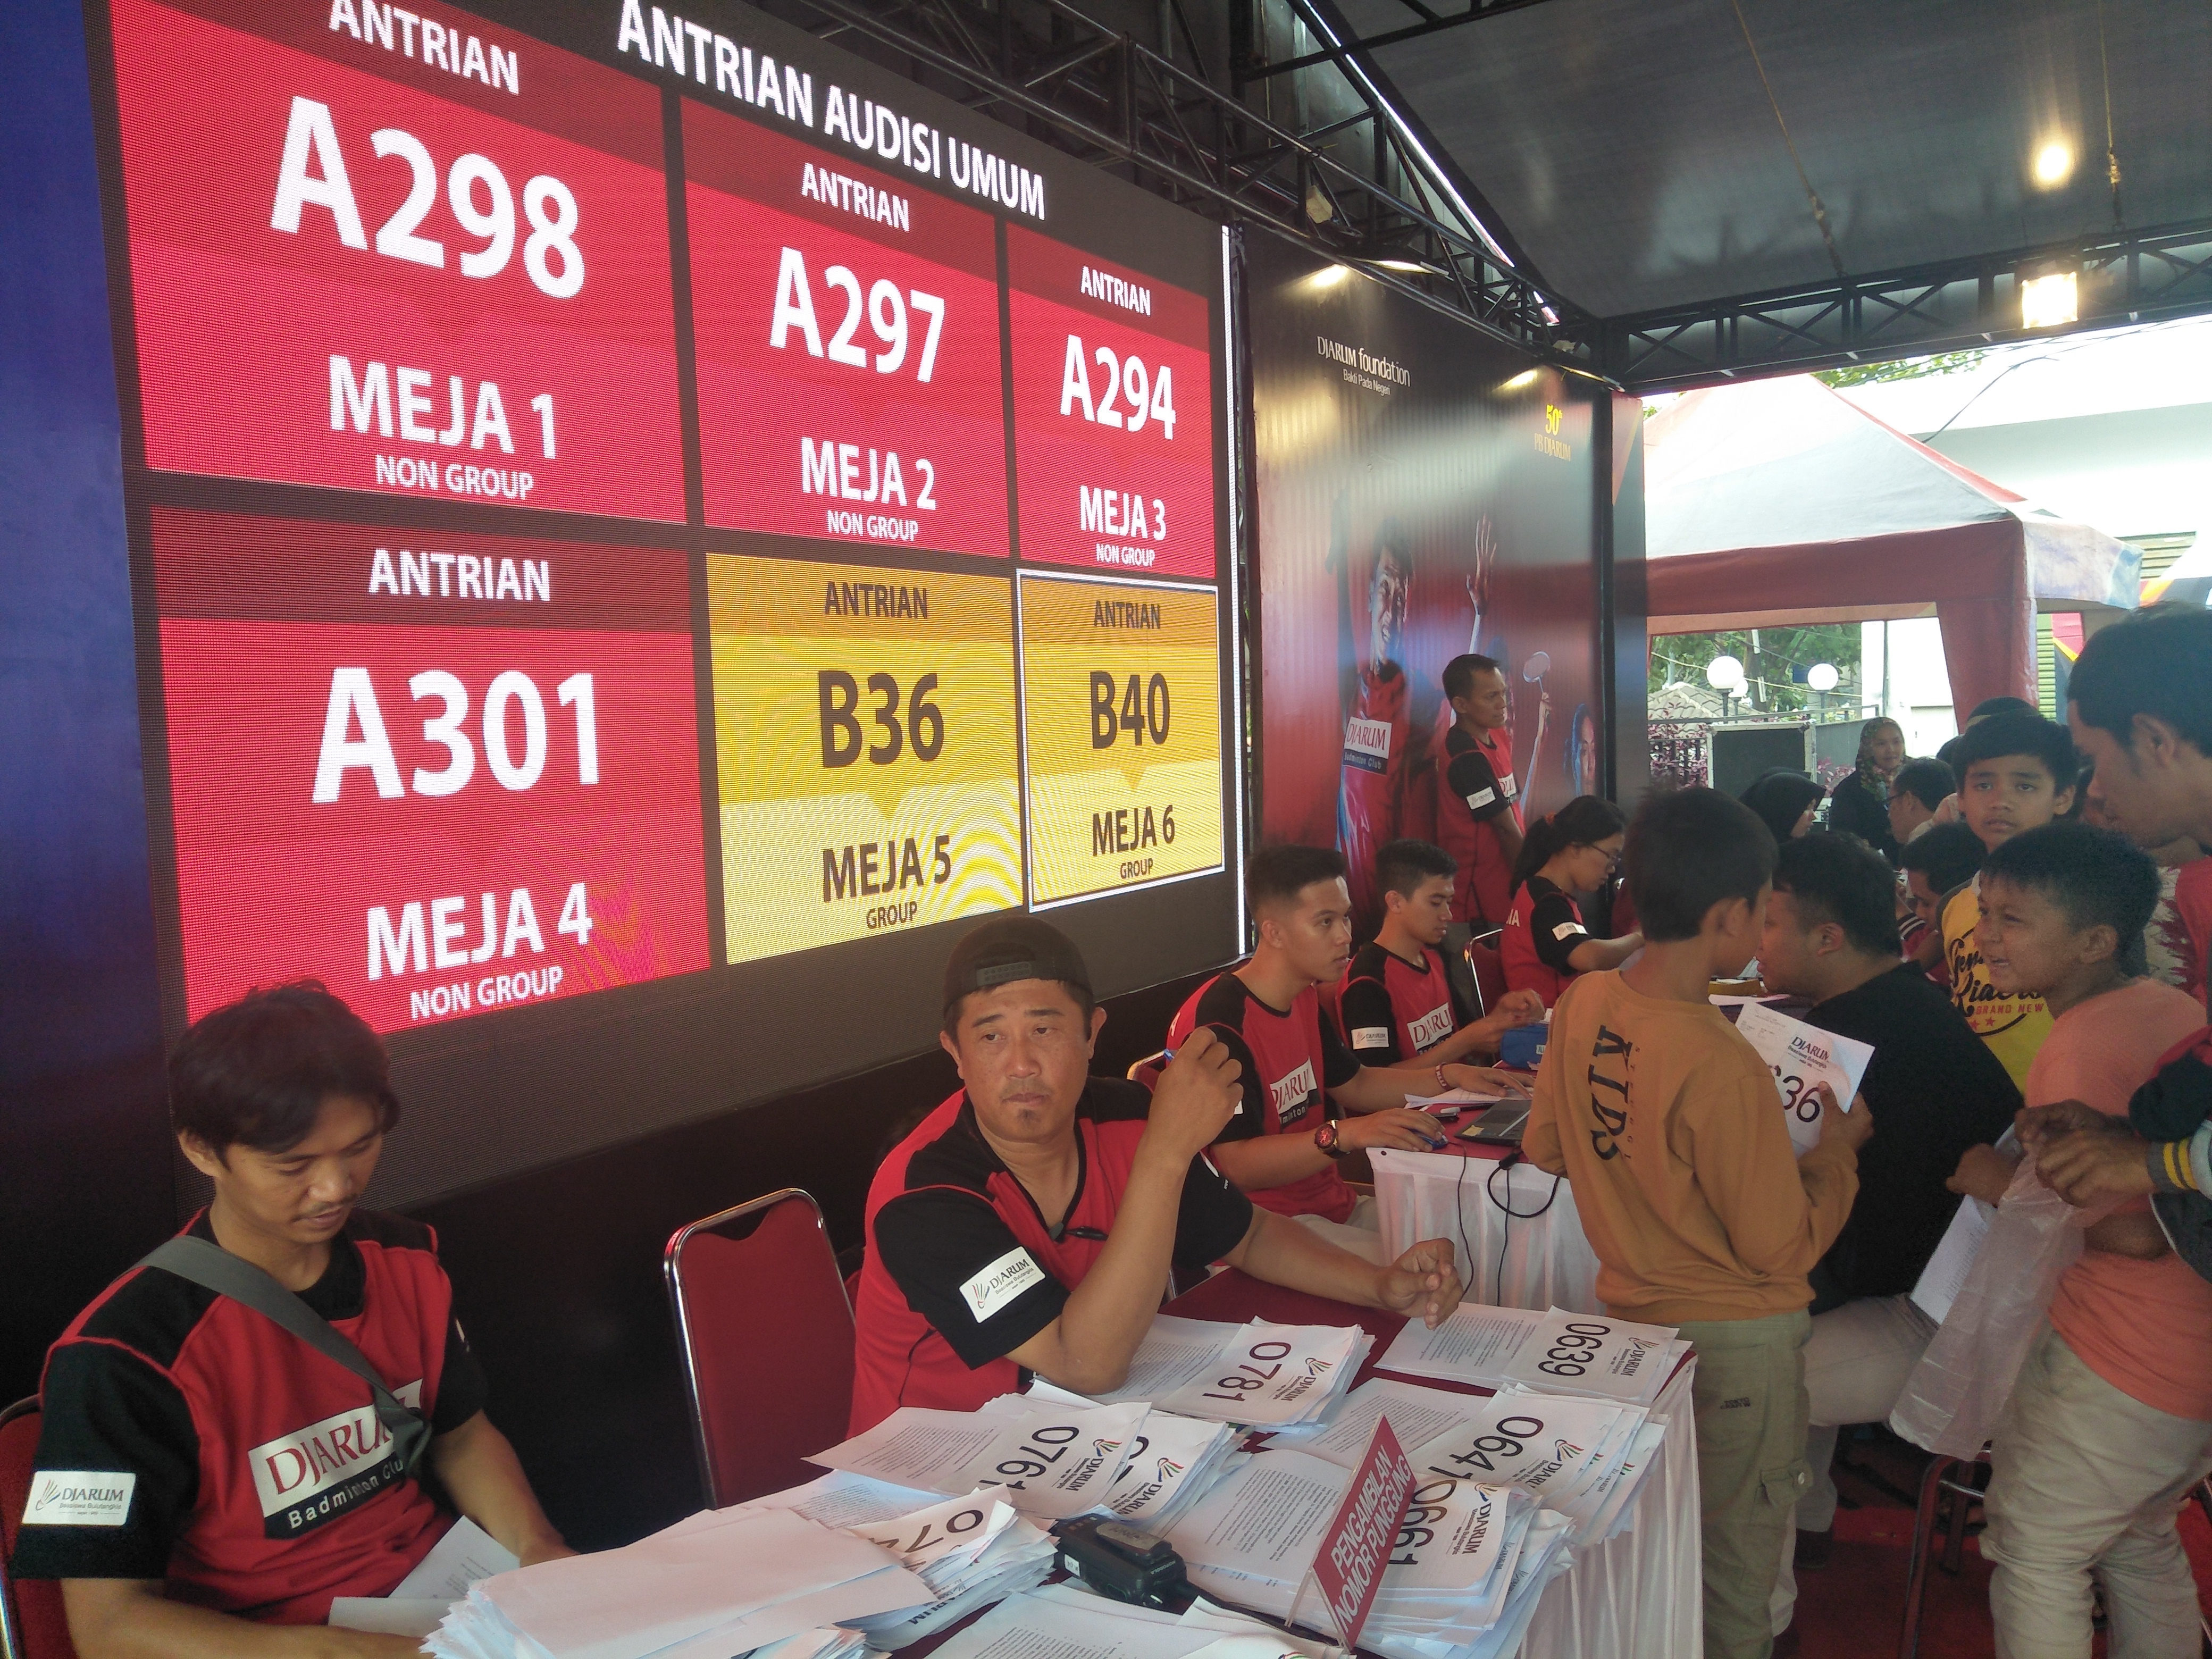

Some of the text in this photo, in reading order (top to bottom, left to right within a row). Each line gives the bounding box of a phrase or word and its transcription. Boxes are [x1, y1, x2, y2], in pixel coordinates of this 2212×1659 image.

[329, 0, 520, 95] ANTRIAN
[617, 0, 1045, 221] ANTRIAN AUDISI UMUM
[270, 96, 585, 299] A298
[801, 162, 910, 232] ANTRIAN
[769, 246, 945, 383] A297
[1080, 265, 1151, 317] ANTRIAN
[1060, 334, 1177, 440] A294
[1317, 336, 1411, 387] DJARUM foundation
[1343, 368, 1391, 396] Bakti Pada Negeri
[329, 355, 557, 459] MEJA 1
[801, 437, 937, 510] MEJA 2
[1535, 433, 1571, 462] PB DJARUM
[375, 454, 534, 500] NON GROUP
[827, 509, 919, 542] NON GROUP
[1079, 485, 1167, 541] MEJA 3
[367, 548, 551, 601] ANTRIAN
[1096, 543, 1155, 568] NON GROUP
[824, 582, 928, 619] ANTRIAN
[1093, 600, 1162, 630] ANTRIAN
[312, 666, 600, 804] A301
[818, 669, 944, 769] B36
[1090, 672, 1170, 750] B40
[1347, 723, 1386, 751] DJARUM
[1368, 757, 1382, 770] Club
[1092, 805, 1176, 858] MEJA 6
[822, 835, 952, 902] MEJA 5
[1119, 858, 1154, 879] GROUP
[366, 882, 593, 981] MEJA 4
[866, 901, 919, 931] GROUP
[410, 966, 564, 1020] NON GROUP
[1975, 1002, 2045, 1015] BRAND NEW
[1588, 1025, 1632, 1161] KIDS
[990, 1258, 1030, 1289] DJARUM
[1202, 1342, 1292, 1402] 0781
[1538, 1323, 1611, 1377] 0639
[1620, 1349, 1646, 1377] DJARUM
[1280, 1376, 1317, 1402] DJARUM
[382, 1459, 404, 1480] Clu
[978, 1426, 1080, 1490] 0761
[1065, 1457, 1105, 1492] DJARUM
[1428, 1416, 1544, 1480] 0641
[62, 1488, 124, 1502] DJARUM
[1330, 1444, 1393, 1579] PENGAMBILAN
[1334, 1454, 1412, 1633] NOMOR PUNGGUNG
[1388, 1479, 1457, 1565] 0661
[1462, 1502, 1492, 1554] DJARUM
